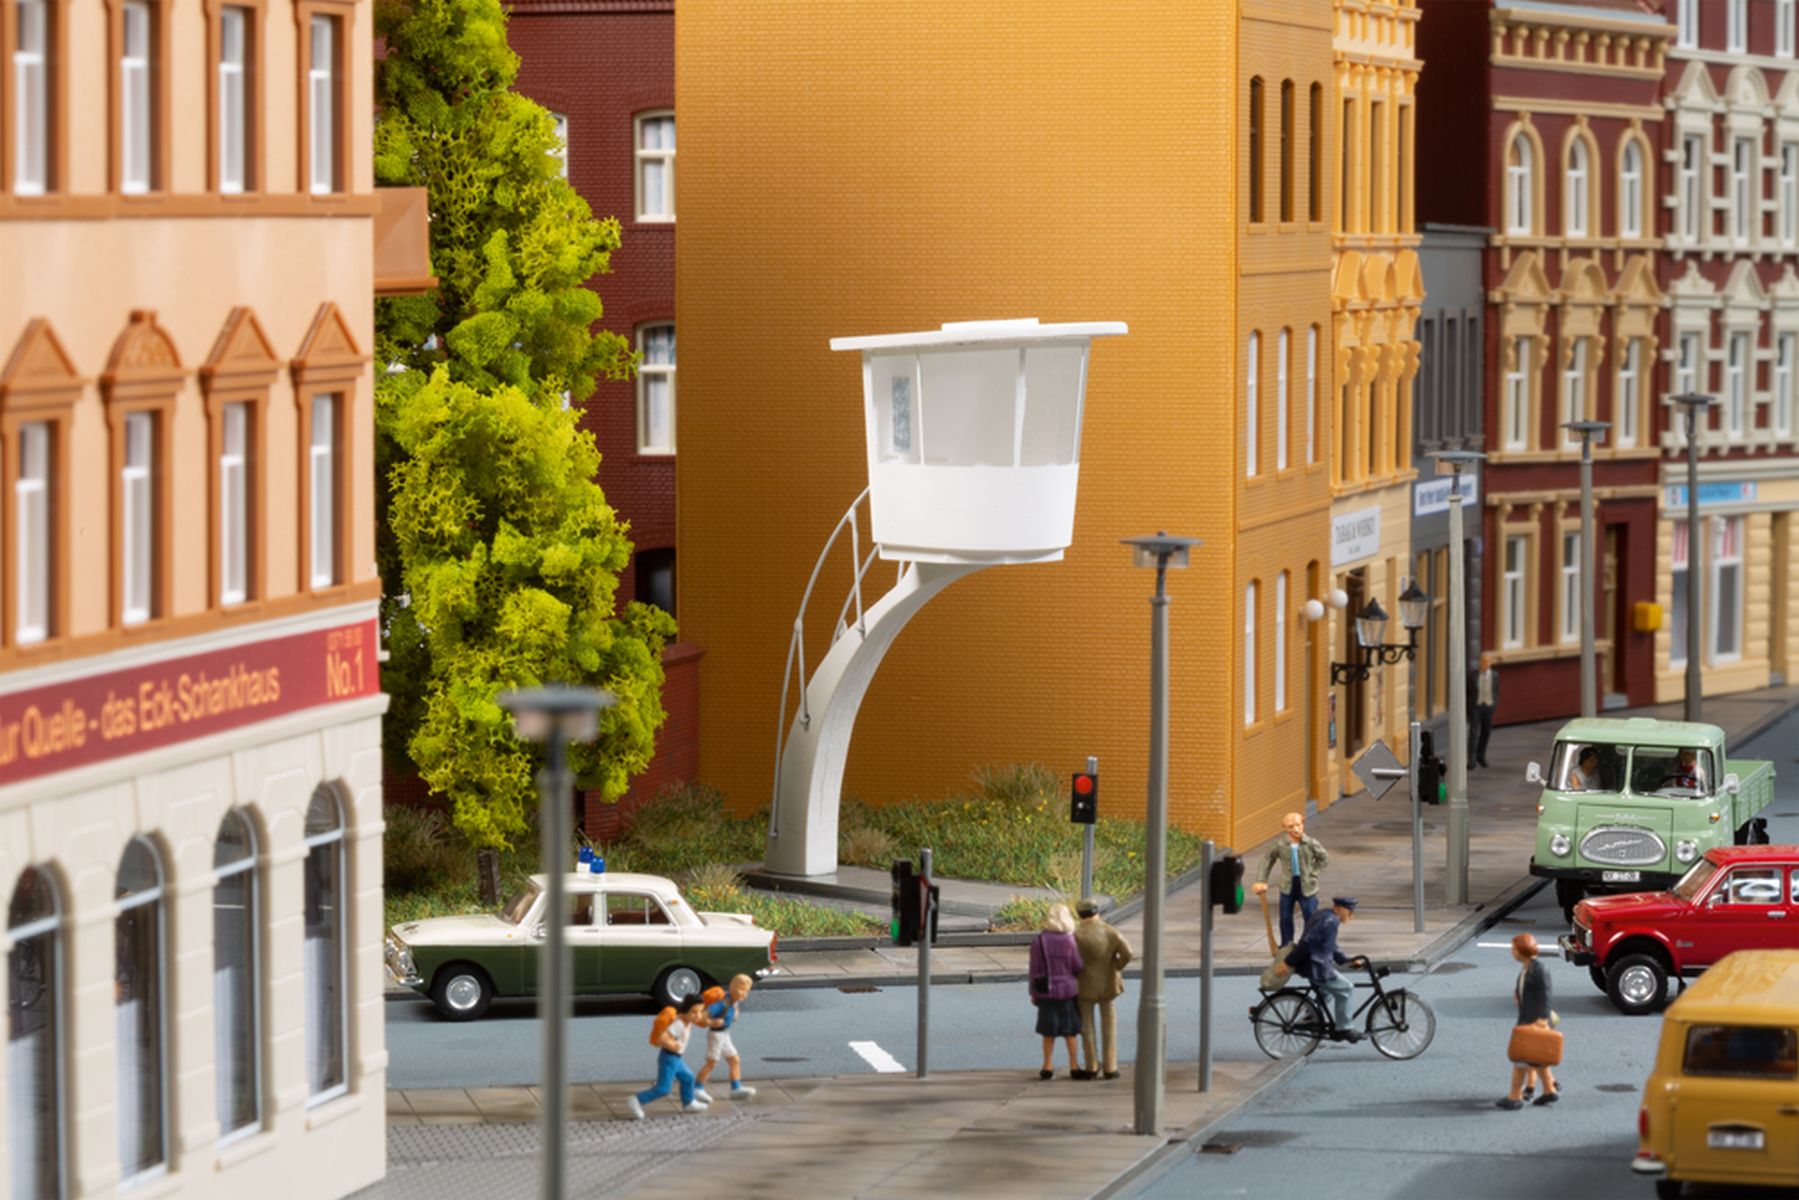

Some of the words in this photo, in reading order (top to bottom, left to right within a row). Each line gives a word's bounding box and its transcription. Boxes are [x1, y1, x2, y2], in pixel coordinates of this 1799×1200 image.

[327, 647, 364, 699] No.1
[22, 697, 87, 759] Quelle
[101, 689, 136, 741] das
[139, 662, 280, 732] Eck-Schankhaus
